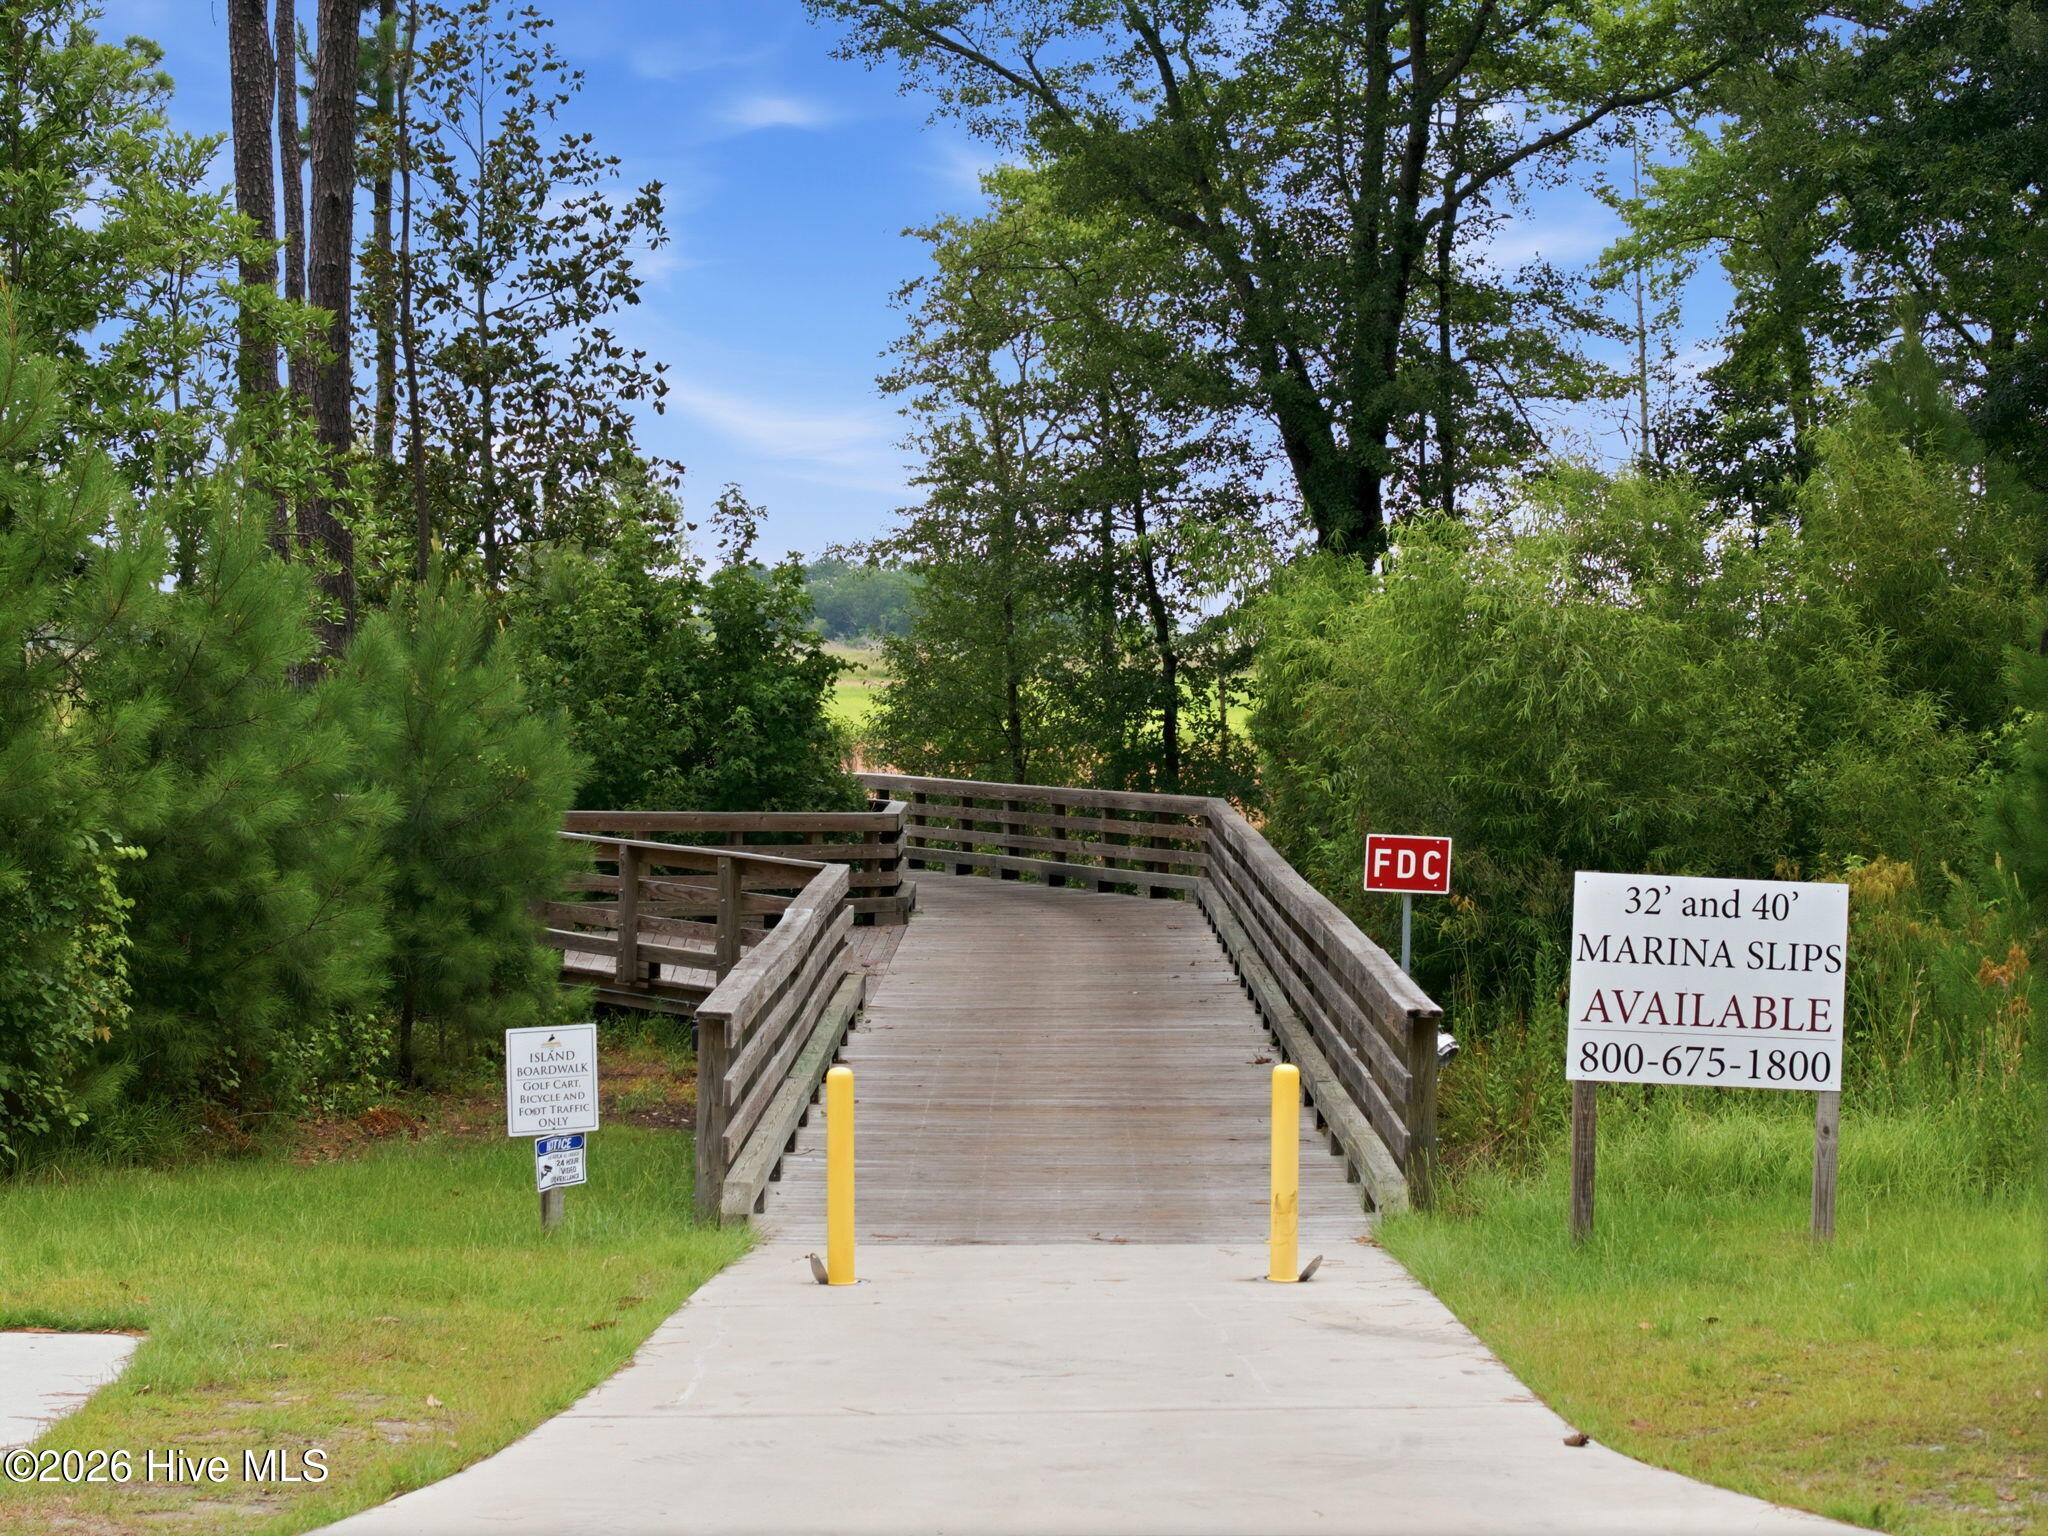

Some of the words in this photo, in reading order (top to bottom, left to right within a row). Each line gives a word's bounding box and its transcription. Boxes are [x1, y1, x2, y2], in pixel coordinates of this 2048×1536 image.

[1373, 848, 1441, 880] FDC
[1624, 885, 1672, 915] 32'
[1682, 888, 1741, 918] and
[1751, 891, 1799, 921] 40'
[1576, 933, 1735, 968] MARINA
[1746, 941, 1842, 973] SLIPS
[1580, 988, 1832, 1032] AVAILABLE
[529, 1050, 575, 1063] ISLAND
[1579, 1041, 1831, 1083] 800-675-1800
[517, 1063, 588, 1077] BOARDWALK
[522, 1081, 550, 1091] GOLF
[520, 1093, 561, 1104] BICYCLE
[563, 1091, 585, 1101] AND
[519, 1106, 546, 1116] FOOT
[549, 1103, 590, 1114] TRAFFIC
[538, 1117, 569, 1128] ONLY
